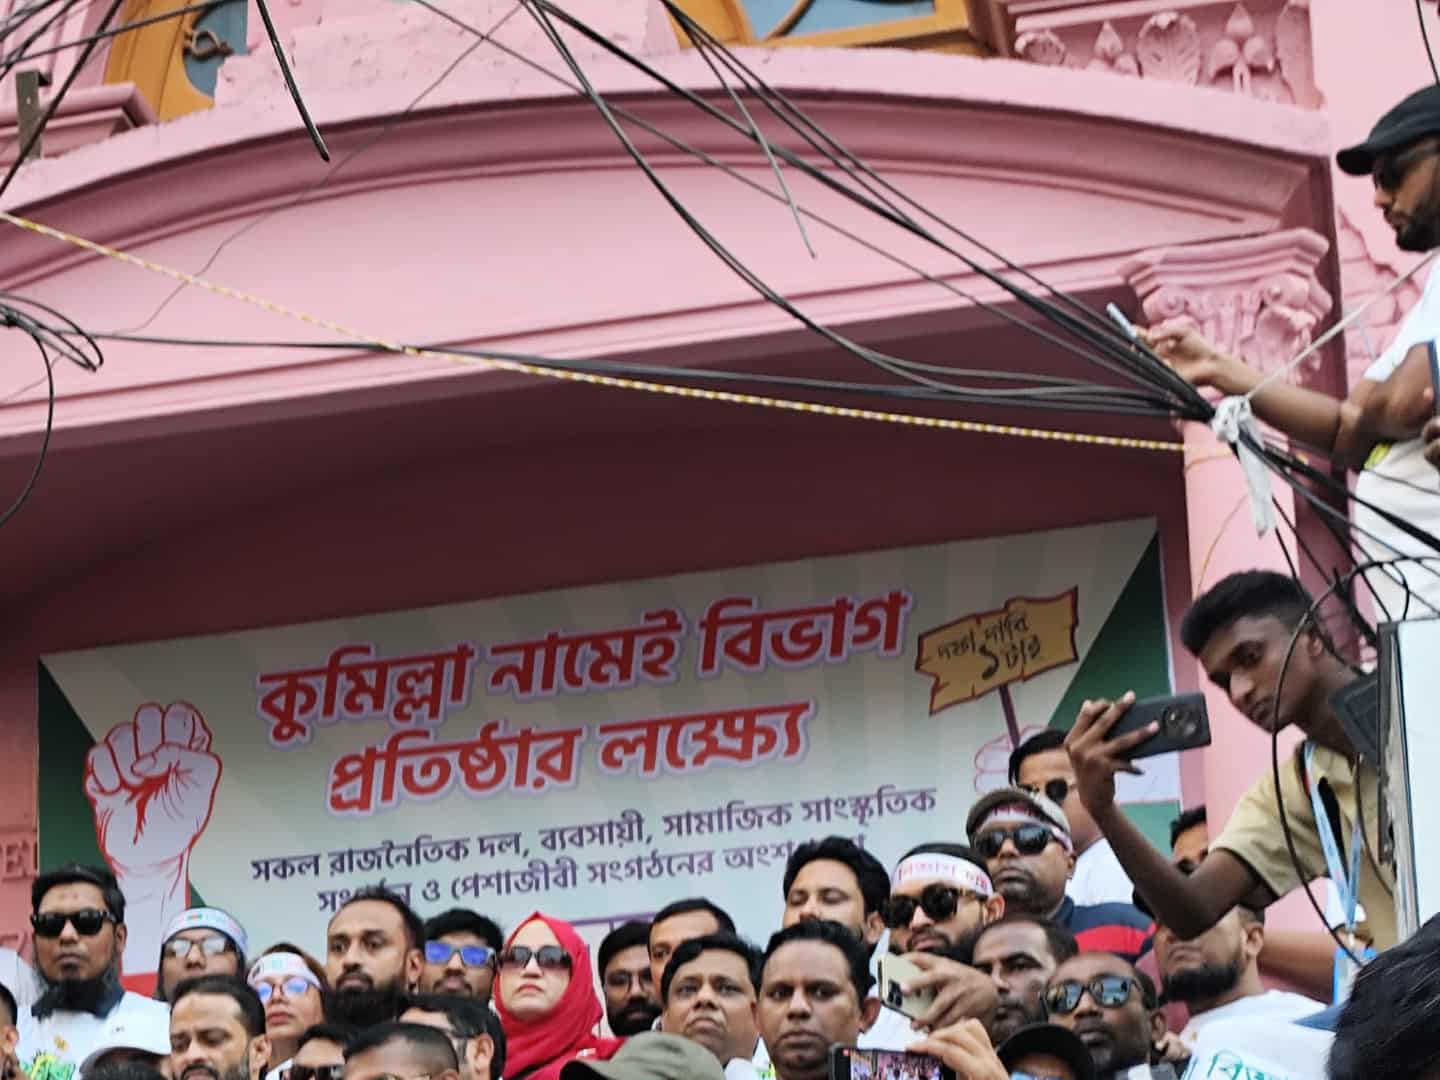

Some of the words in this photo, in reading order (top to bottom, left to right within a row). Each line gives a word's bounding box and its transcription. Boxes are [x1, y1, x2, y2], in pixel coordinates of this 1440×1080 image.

[259, 644, 474, 742] কুমিল্লা
[491, 609, 682, 694] নামেই
[699, 590, 909, 672] বিভাগ
[328, 721, 583, 812] প্রতিষ্ঠার
[251, 853, 320, 882] সকল
[328, 834, 469, 877] রাজনৈতিক
[478, 831, 529, 859] দল,
[663, 800, 793, 838] সামাজিক
[801, 784, 937, 826] সাংস্কৃতিক
[422, 880, 440, 902] ও
[452, 856, 578, 897] পেশাজীবী
[587, 847, 714, 884] সংগঠনের
